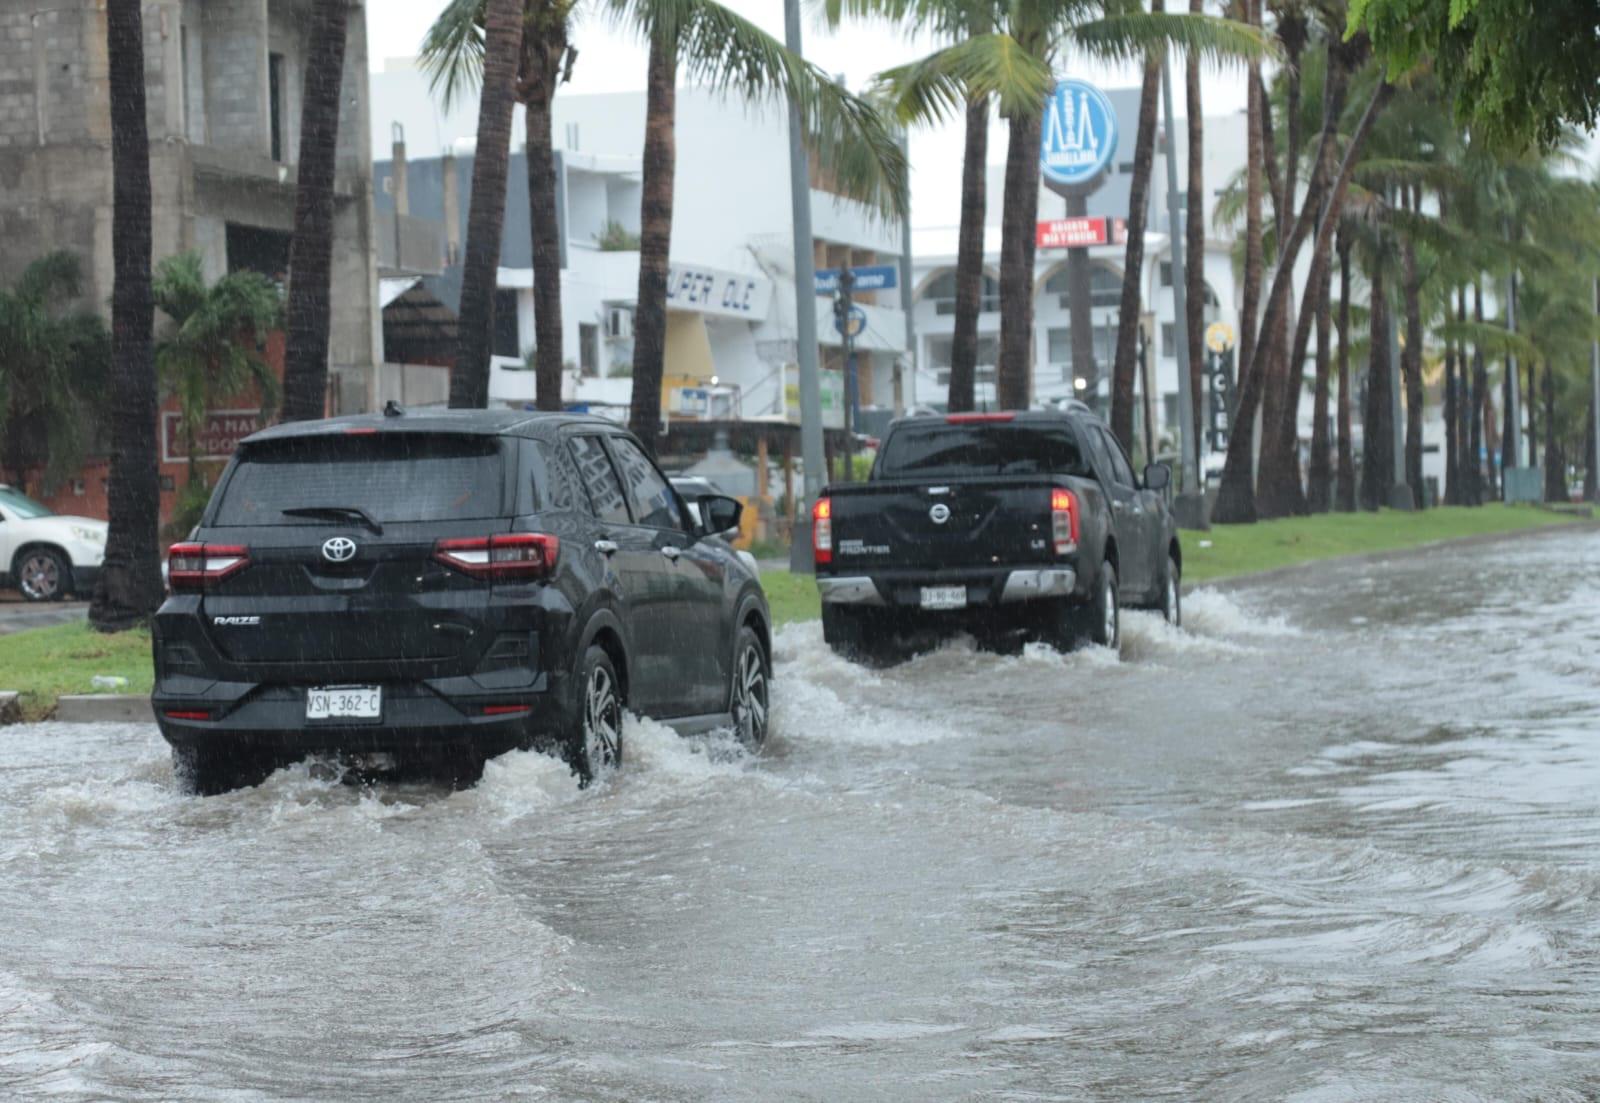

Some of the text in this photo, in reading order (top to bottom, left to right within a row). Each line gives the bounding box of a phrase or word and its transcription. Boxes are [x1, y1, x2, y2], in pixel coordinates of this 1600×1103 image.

[667, 271, 714, 304] UPER
[214, 616, 260, 625] RAIZE
[308, 694, 377, 712] VSN-362-C
